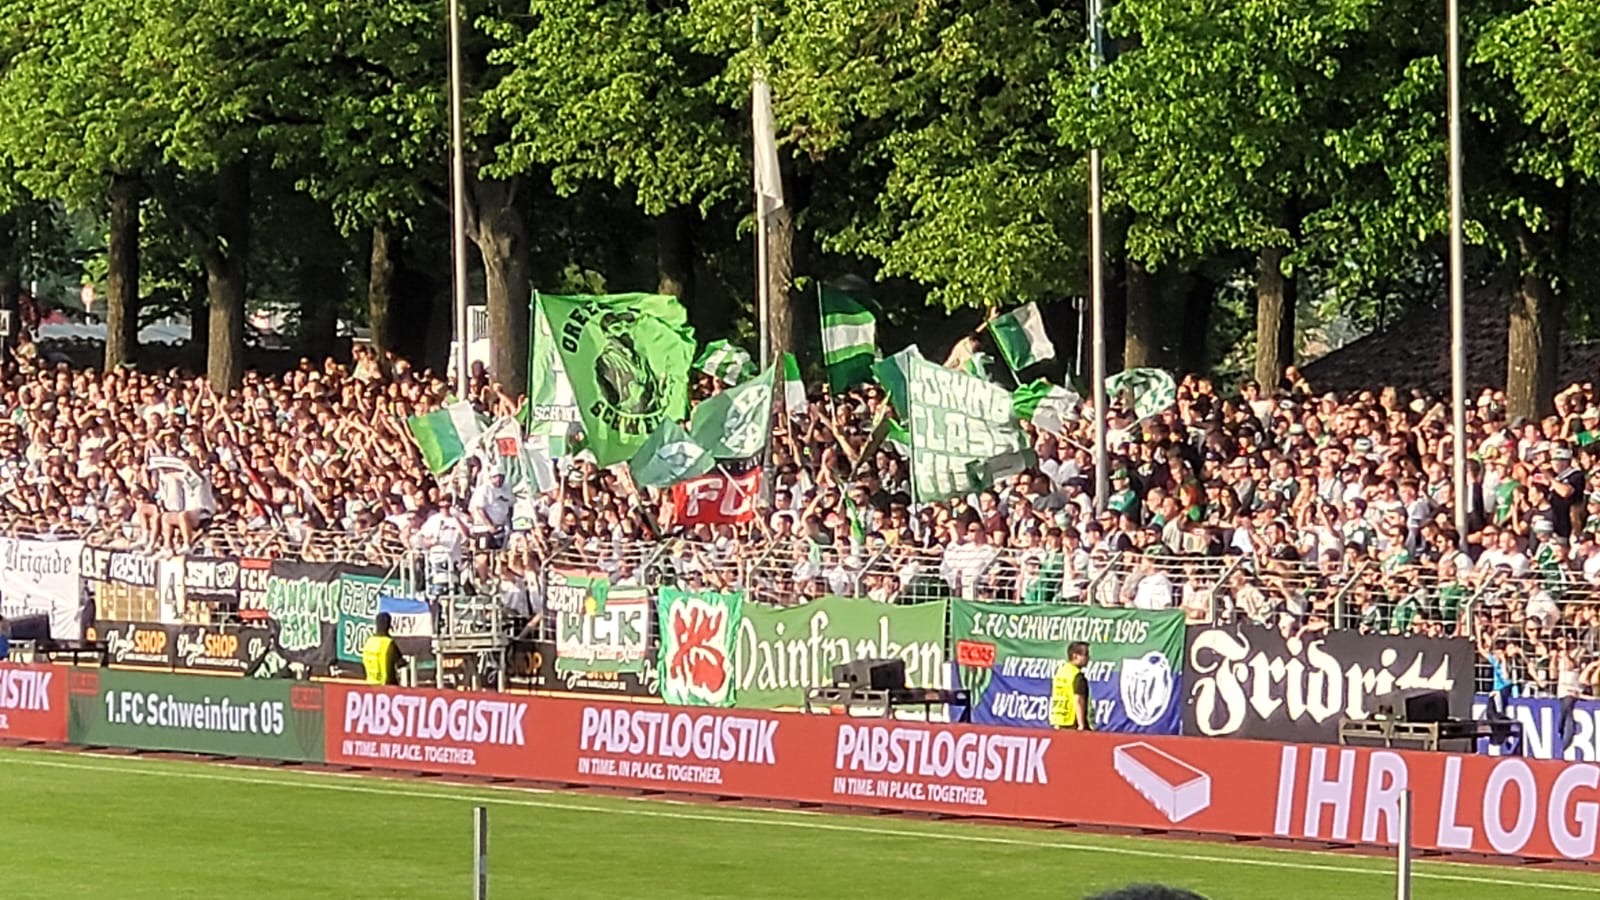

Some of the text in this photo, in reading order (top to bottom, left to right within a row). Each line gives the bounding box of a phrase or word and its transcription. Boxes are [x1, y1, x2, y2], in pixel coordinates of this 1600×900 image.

[134, 630, 167, 653] SHOP
[986, 614, 1006, 638] FC
[1007, 616, 1113, 643] SCHWEINFURT
[1114, 620, 1149, 643] 1905
[205, 634, 237, 657] SHOP
[1002, 656, 1017, 677] IN
[105, 690, 145, 724] 1.FC
[147, 694, 258, 733] Schweinfurt
[261, 702, 284, 735] 05
[344, 691, 528, 745] PABSTLOGISTIK
[580, 707, 779, 764] PABSTLOGISTIK
[342, 740, 476, 765] IN TIME. IN PLACE. TOGETHER.
[836, 724, 1051, 784] PABSTLOGISTIK
[578, 758, 723, 784] IN TIME. IN PLACE. TOGETHER.
[833, 777, 987, 805] IN TIME. IN PLACE. TOGETHER.
[1274, 746, 1600, 859] IHR LOG
